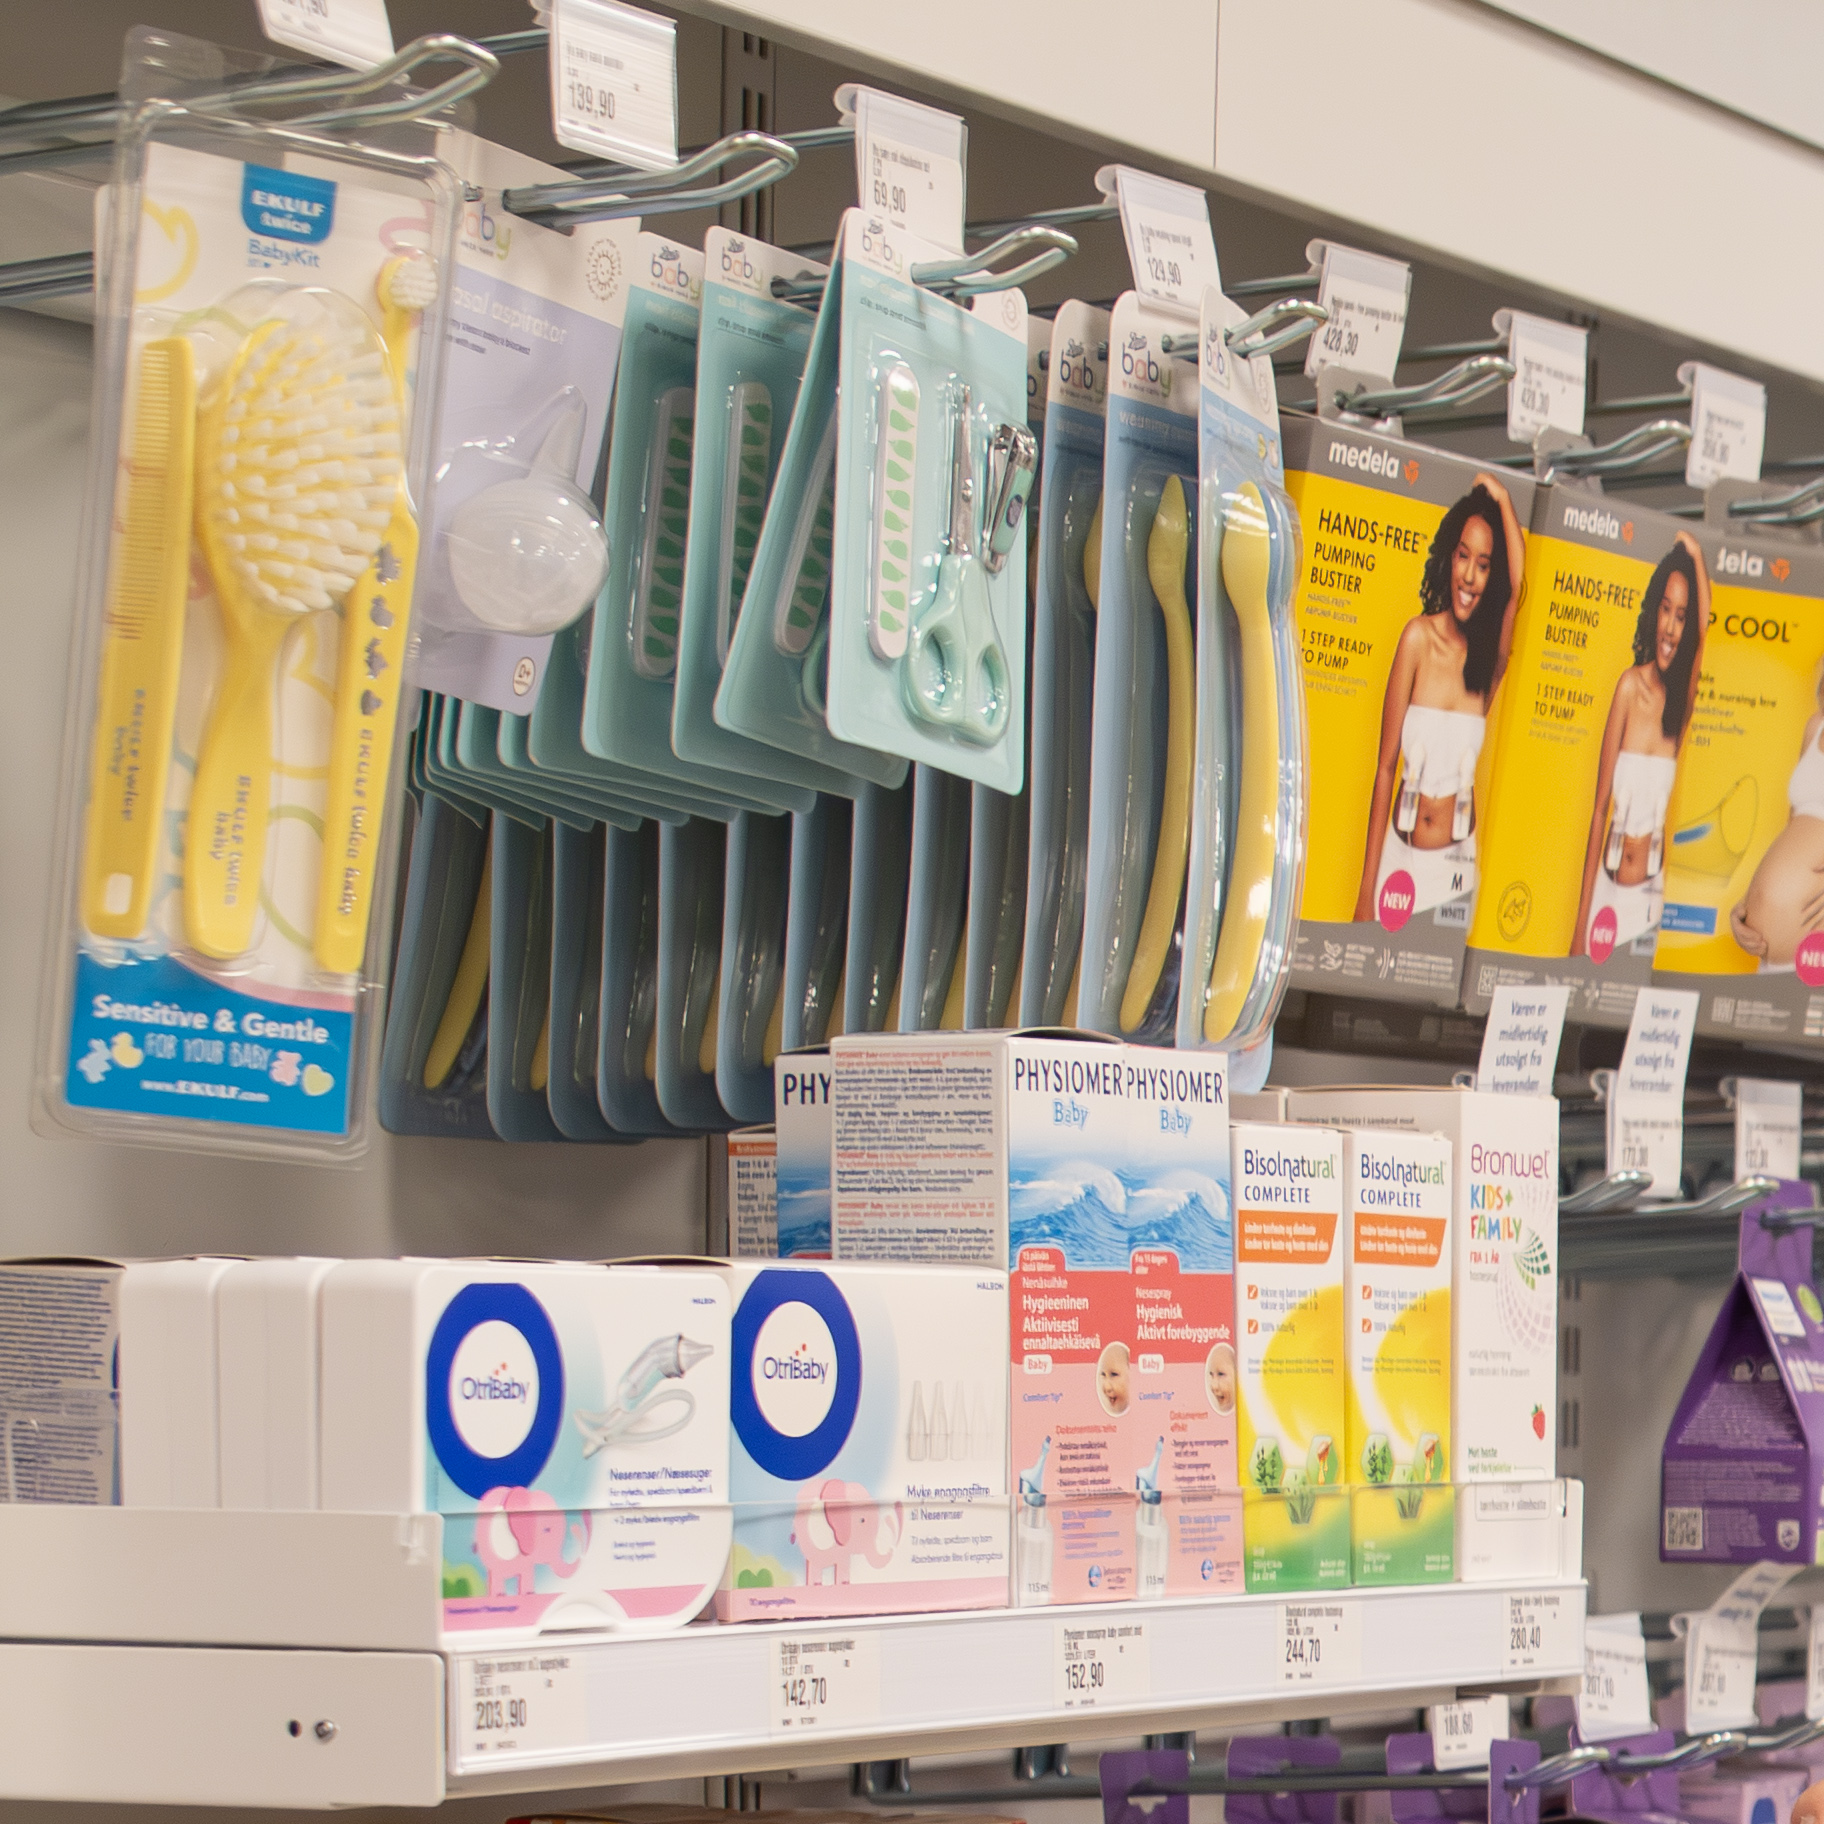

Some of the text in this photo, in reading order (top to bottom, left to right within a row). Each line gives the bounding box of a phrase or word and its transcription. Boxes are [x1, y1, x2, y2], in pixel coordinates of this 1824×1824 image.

[568, 80, 616, 120] 139,90
[251, 189, 326, 218] EKULF
[874, 180, 906, 214] 69,90
[260, 212, 313, 236] twice
[862, 227, 903, 274] baby
[722, 247, 763, 286] baby
[1147, 256, 1182, 288] 129,90
[491, 302, 568, 346] aspirator
[1323, 325, 1359, 358] 428,30
[1121, 342, 1173, 398] baby
[1328, 440, 1400, 479] medela
[1317, 508, 1421, 554] HANDS-FREE
[1563, 505, 1620, 541] medela
[1312, 541, 1377, 573] PUMPING
[1309, 567, 1363, 595] BUSTIER
[1552, 569, 1636, 611] HANDS-FREE
[1548, 601, 1600, 629] PUMPING
[1724, 613, 1792, 644] COOL
[1308, 630, 1374, 657] STEP READY
[1544, 624, 1588, 650] BUSTIER
[1315, 649, 1350, 672] PUMP
[92, 993, 330, 1044] Sensitive & Gentle
[1510, 998, 1548, 1017] Varen er
[144, 1032, 274, 1071] FOR YOUR BABY
[1498, 1025, 1549, 1047] midlertidig
[1495, 1049, 1543, 1072] utsolgt fra
[140, 1079, 271, 1103] www.EKULF.com
[1014, 1057, 1124, 1096] PHYSIOMER
[1125, 1062, 1225, 1104] PHYSIOMER
[1052, 1098, 1090, 1131] Baby
[1158, 1106, 1193, 1139] Baby
[1243, 1149, 1336, 1184] Bisolnatural
[1360, 1153, 1445, 1188] Bisolnatural
[1470, 1143, 1552, 1180] Bronwel
[1243, 1185, 1311, 1205] COMPLETE
[1360, 1188, 1423, 1209] COMPLETE
[1469, 1214, 1522, 1244] FAMILY
[1022, 1294, 1090, 1314] Hygieeninen
[1135, 1286, 1172, 1301] Nesespray
[1022, 1316, 1080, 1333] Aktiivisesti
[1135, 1303, 1183, 1322] Hygienisk
[1137, 1324, 1231, 1343] Aktivt forebyggende
[763, 1355, 829, 1384] OtriBaby
[1027, 1357, 1049, 1372] Baby
[1141, 1358, 1161, 1371] Baby
[460, 1376, 531, 1404] OtriBaby
[1285, 1637, 1322, 1666] 244,70
[1509, 1625, 1543, 1652] 280,40
[781, 1676, 829, 1710] 142,70
[1064, 1661, 1106, 1694] 152,90
[475, 1697, 528, 1733] 203,90
